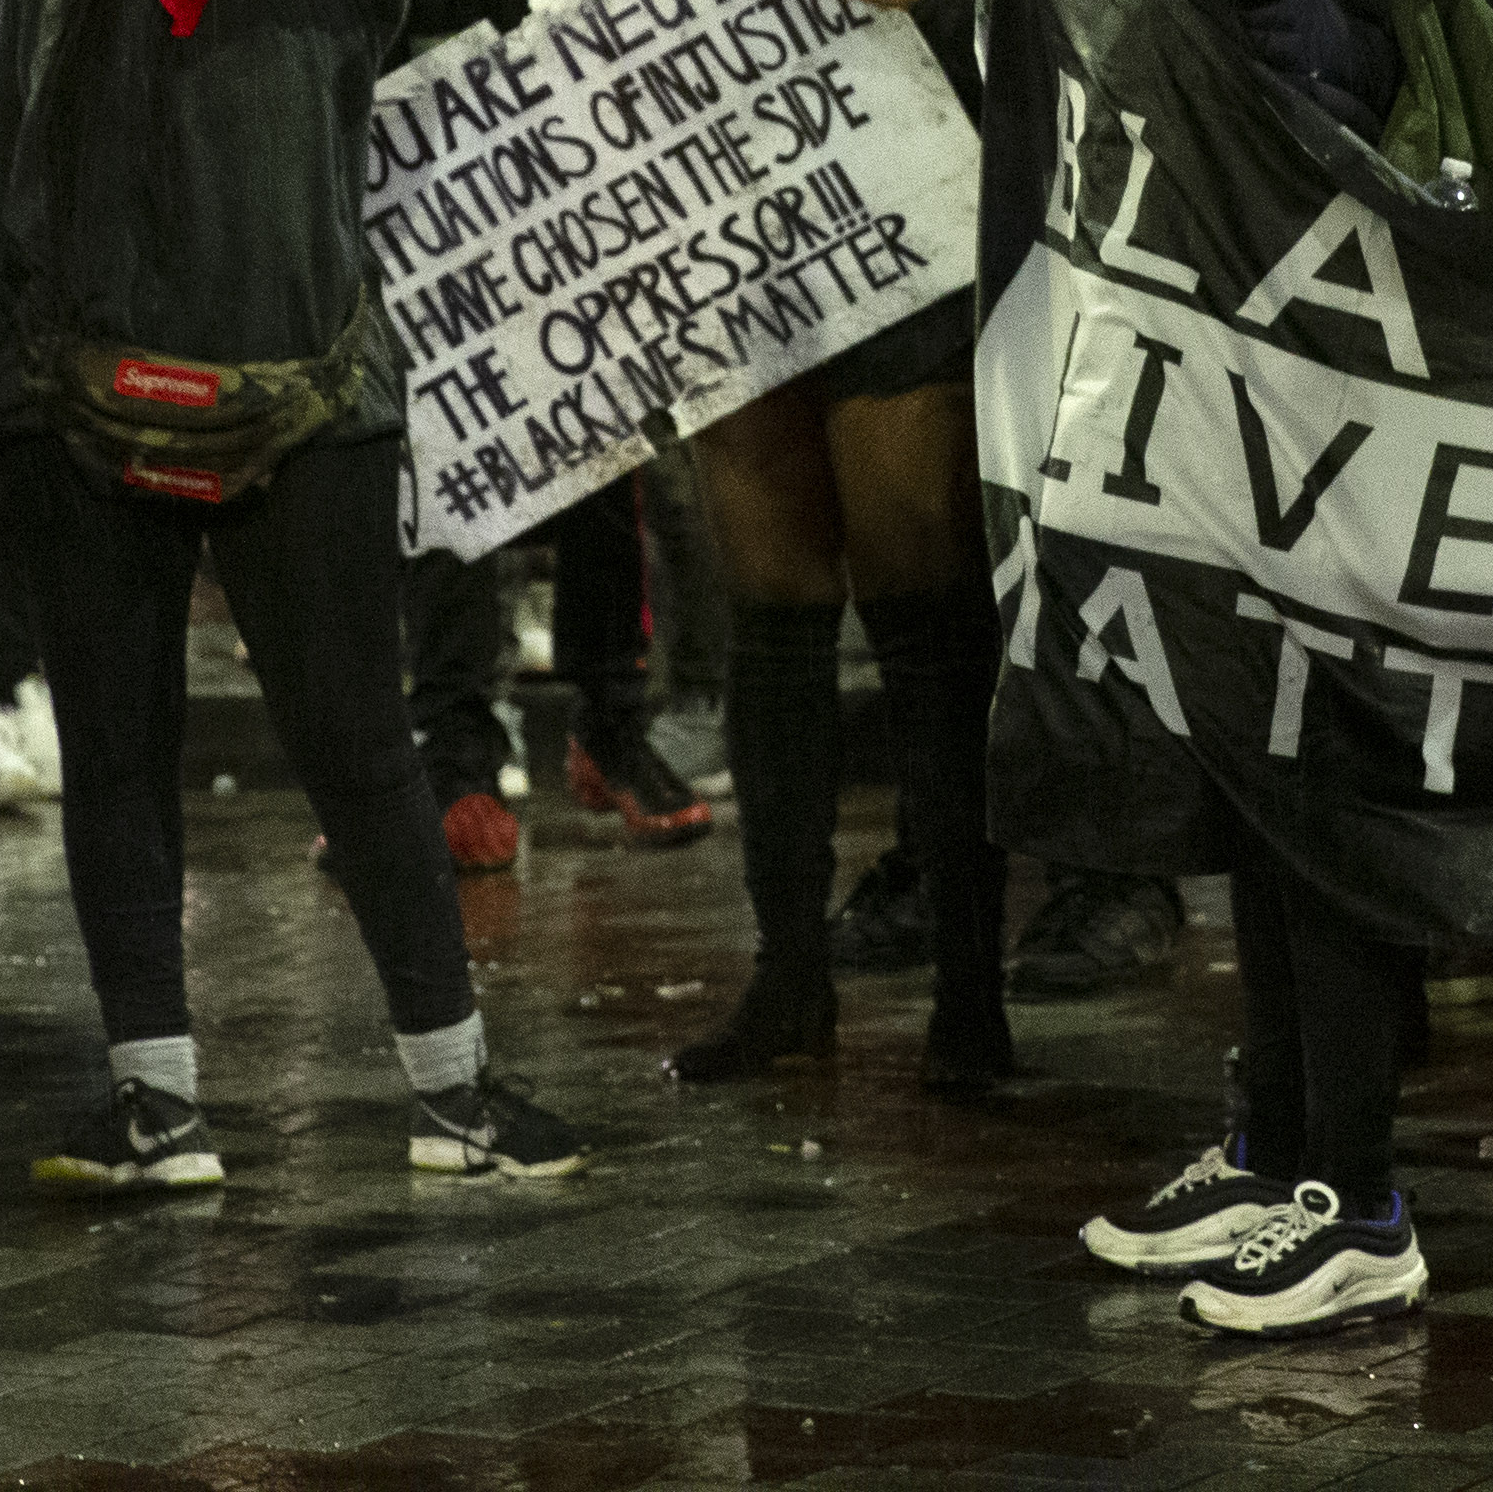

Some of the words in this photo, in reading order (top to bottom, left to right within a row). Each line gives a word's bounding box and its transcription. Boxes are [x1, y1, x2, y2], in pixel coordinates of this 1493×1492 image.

[431, 42, 552, 153] ARE
[393, 250, 524, 361] HAVE
[510, 160, 689, 298] CHOSEN
[661, 113, 770, 206] THE
[753, 60, 870, 164] SIDE
[417, 346, 528, 442] THE
